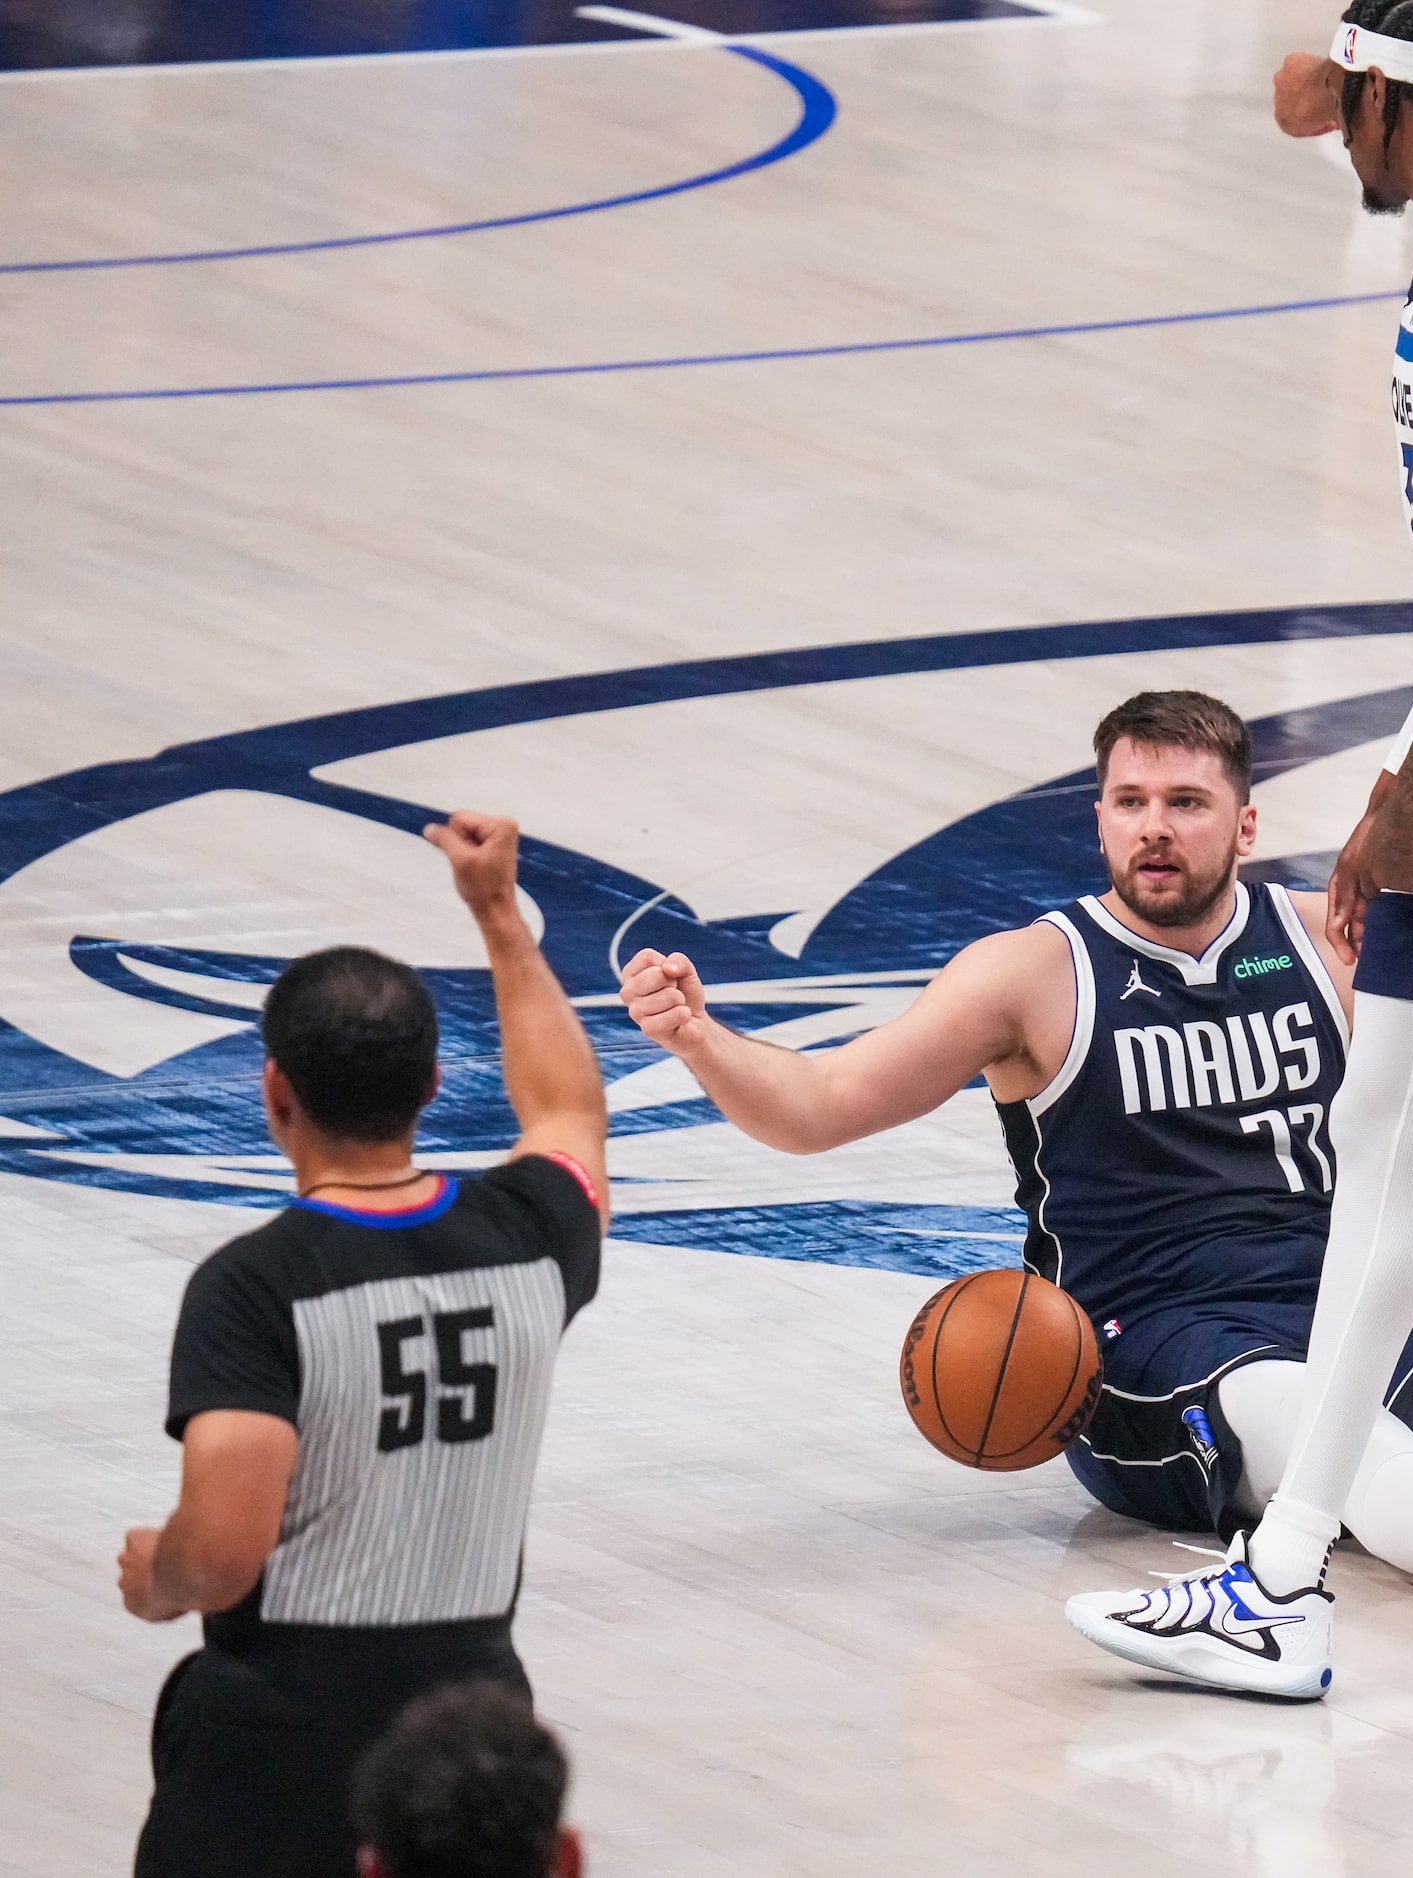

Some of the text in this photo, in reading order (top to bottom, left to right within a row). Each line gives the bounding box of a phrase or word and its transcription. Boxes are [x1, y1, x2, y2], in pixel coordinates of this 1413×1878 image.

[1234, 954, 1293, 978] chime
[1113, 1001, 1321, 1115] MAVS
[1238, 1102, 1333, 1194] 77
[376, 1306, 499, 1454] 55
